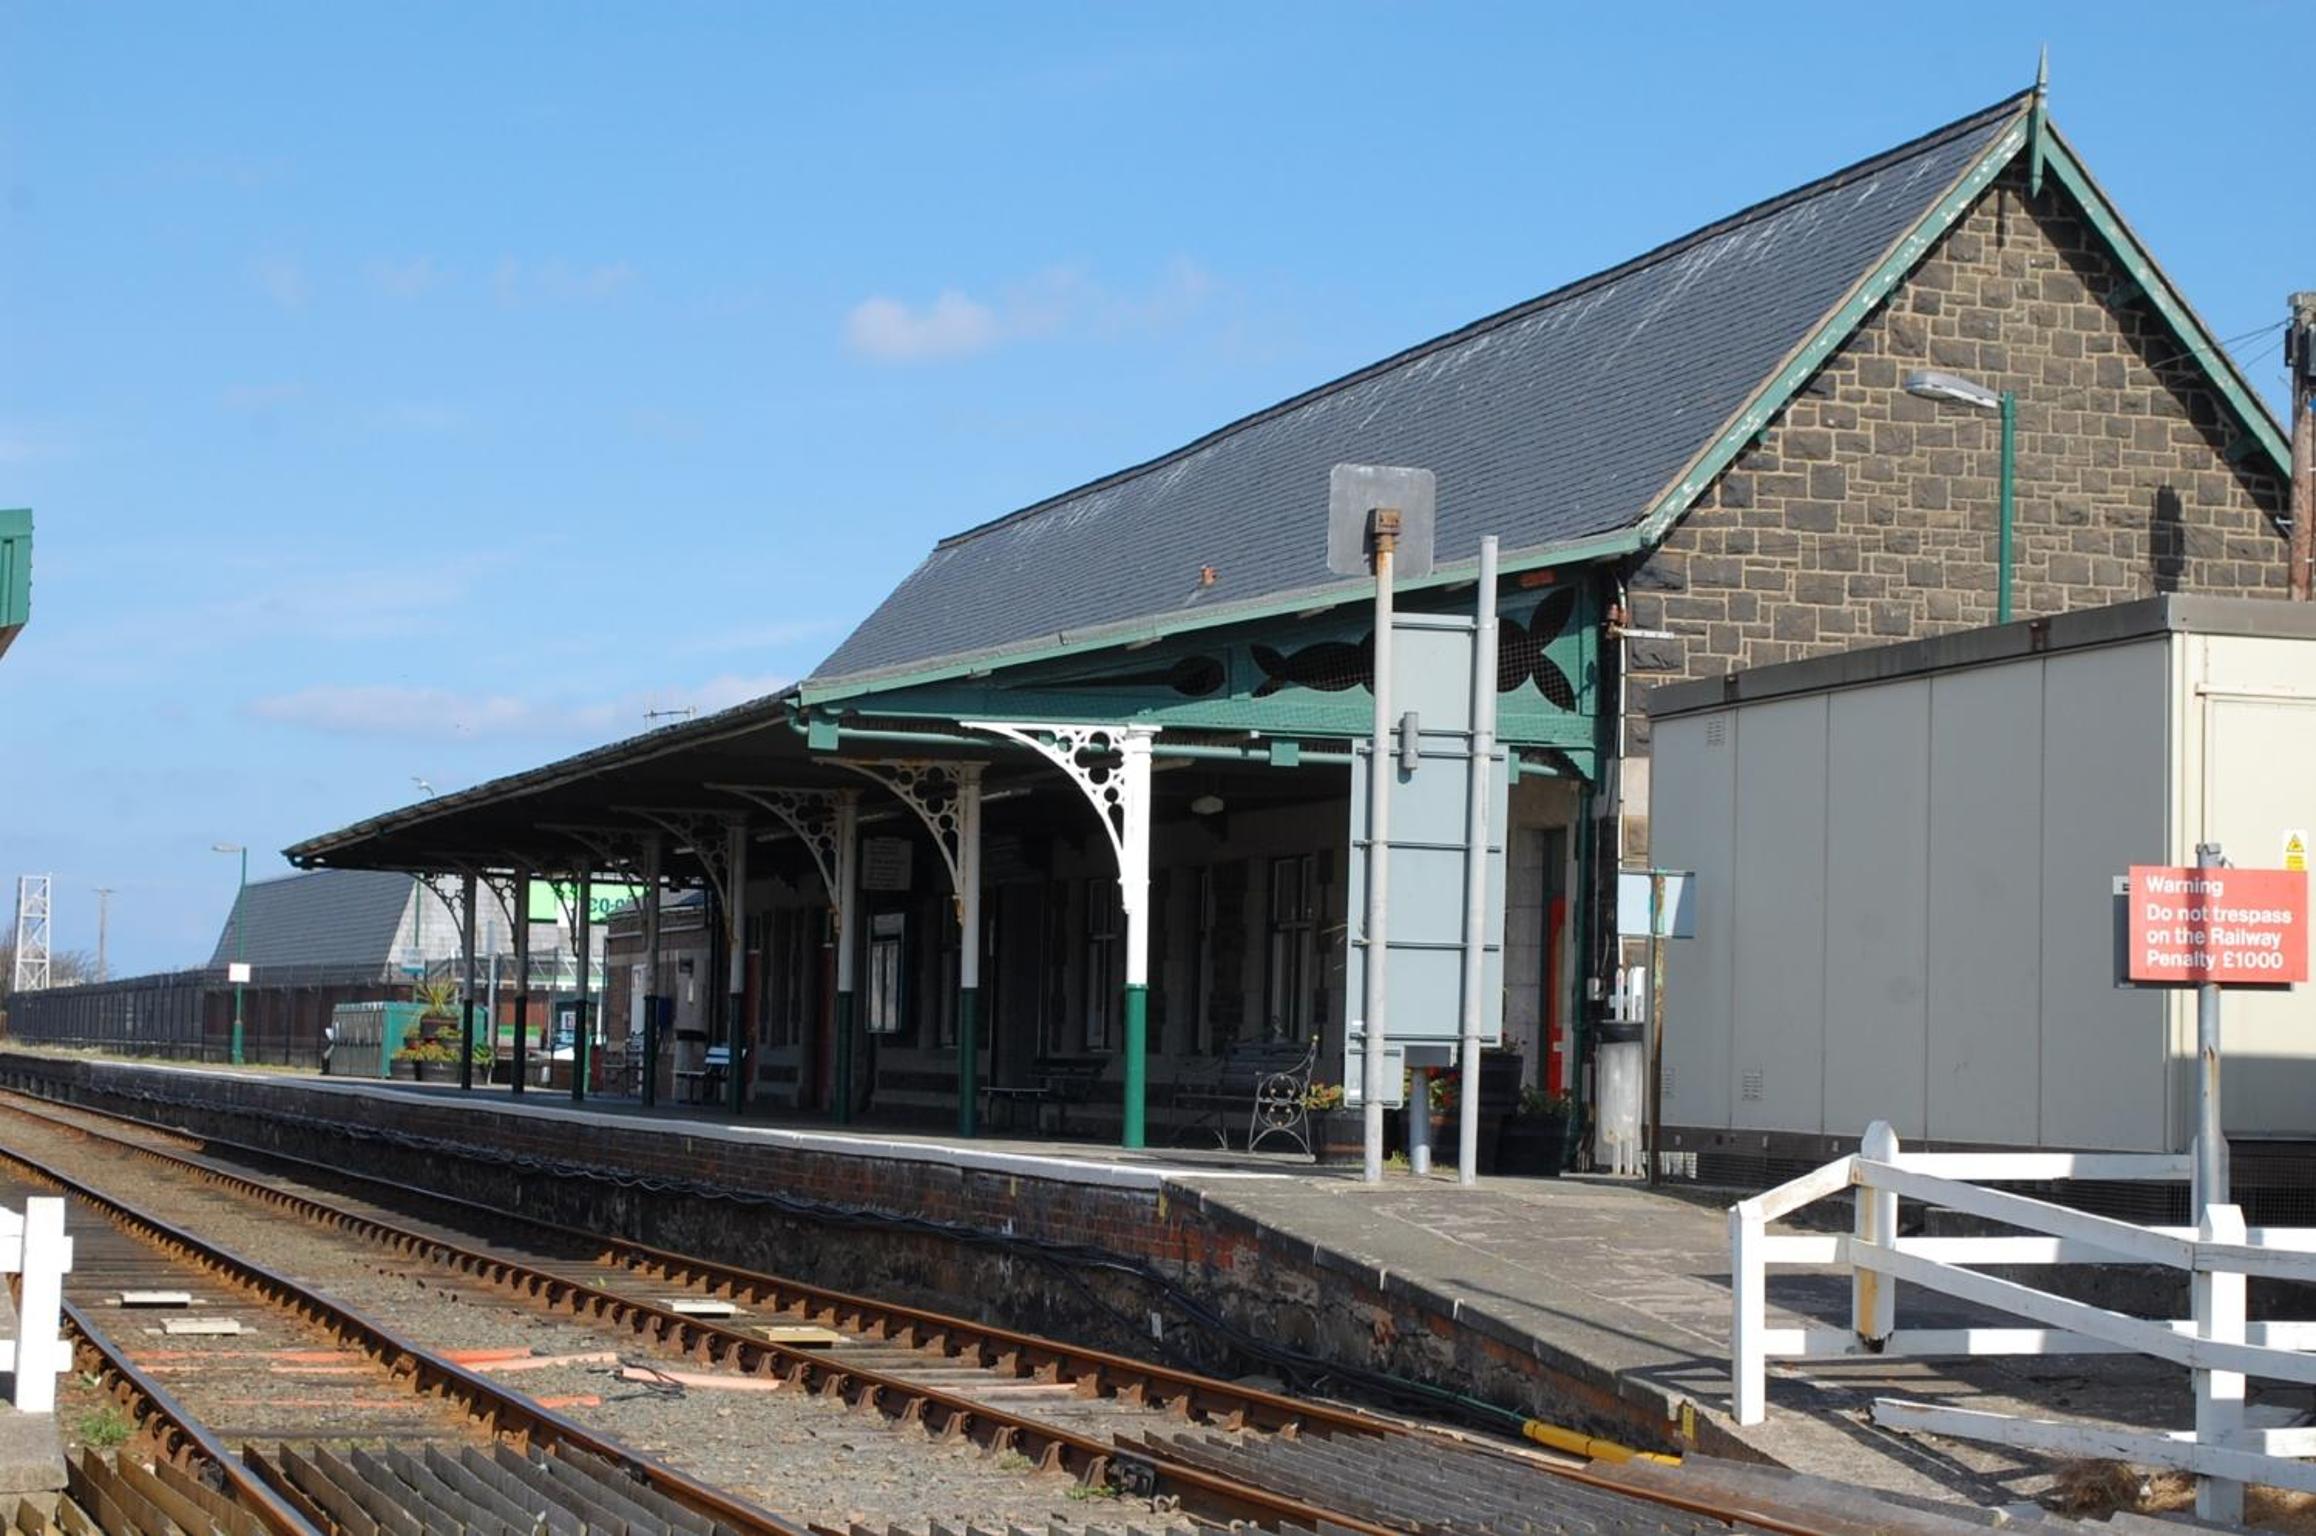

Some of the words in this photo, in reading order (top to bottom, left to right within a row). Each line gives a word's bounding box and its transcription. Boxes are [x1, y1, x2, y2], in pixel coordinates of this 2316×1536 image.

[2147, 876, 2224, 897] Warning
[2146, 904, 2173, 922] Do
[2178, 906, 2208, 922] not
[2213, 907, 2293, 925] trespass
[2147, 929, 2169, 944] on
[2175, 928, 2205, 945] the
[2211, 928, 2281, 949] Railway
[2146, 951, 2216, 971] Penalty
[2223, 953, 2283, 968] £1000
